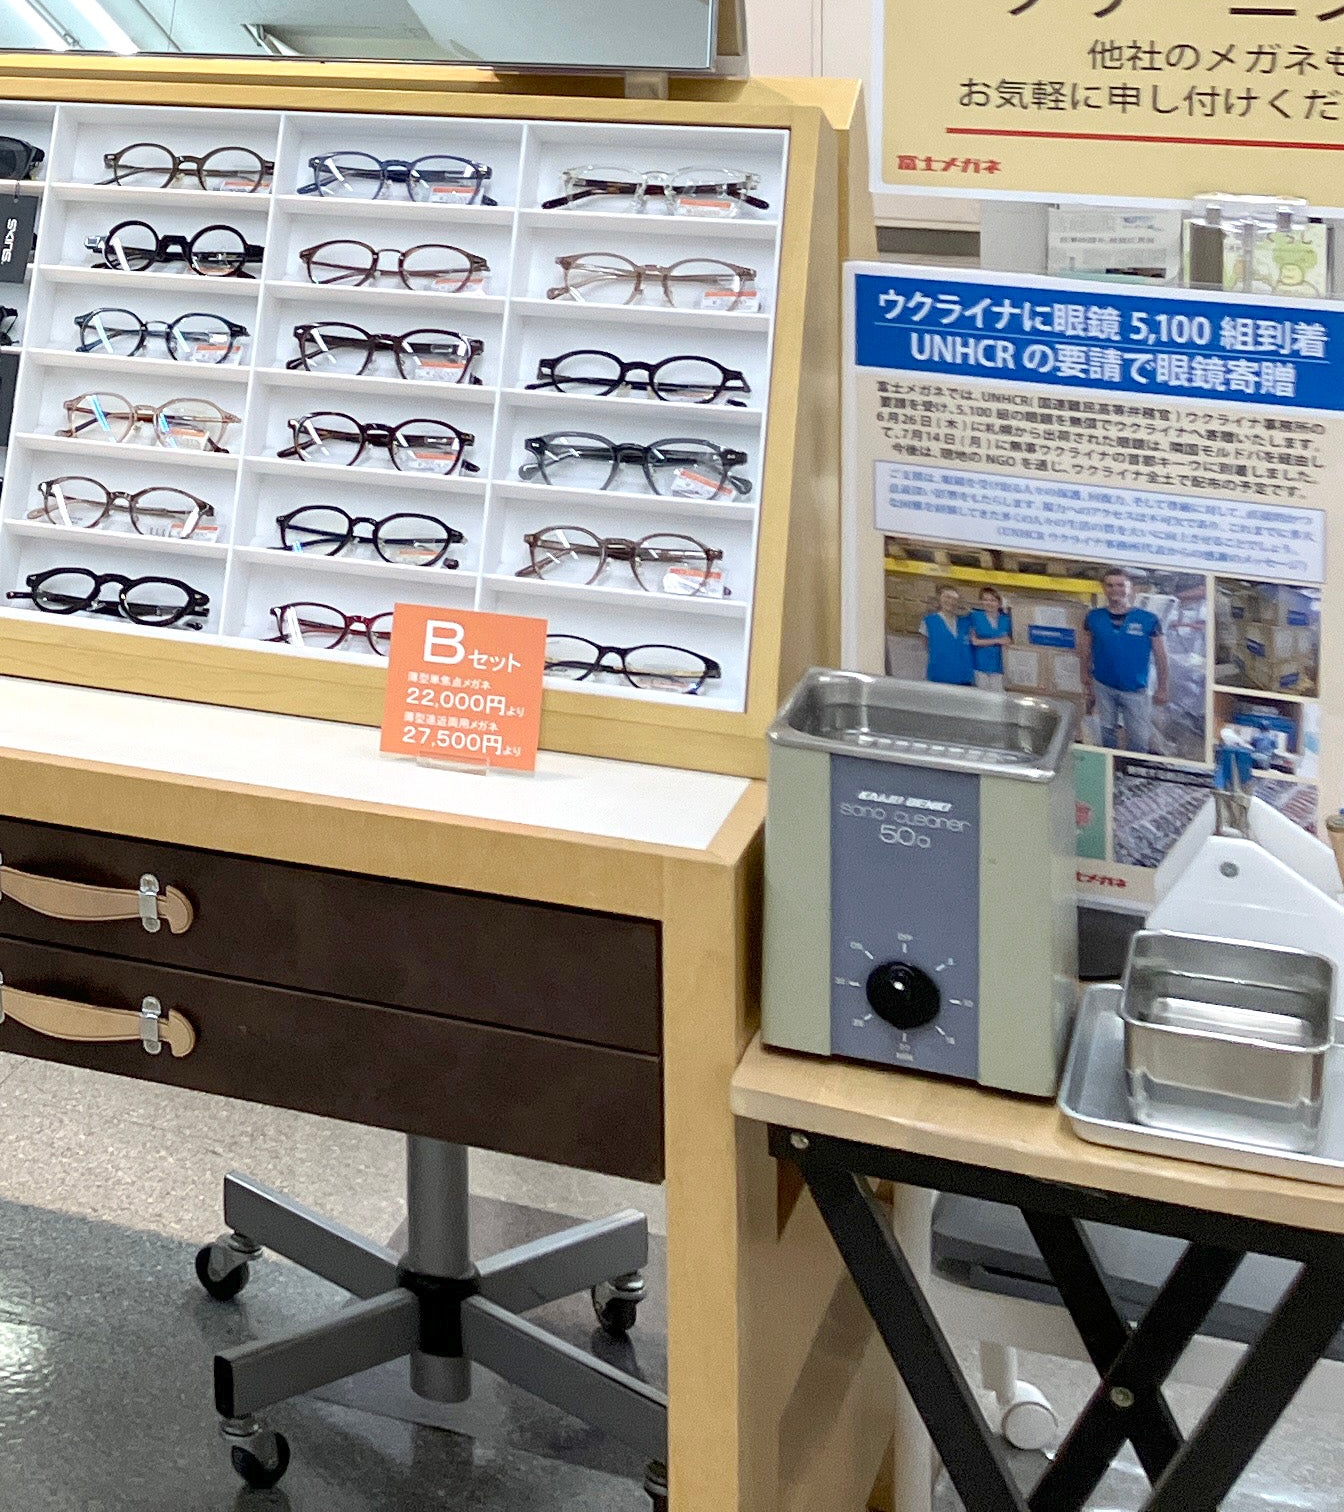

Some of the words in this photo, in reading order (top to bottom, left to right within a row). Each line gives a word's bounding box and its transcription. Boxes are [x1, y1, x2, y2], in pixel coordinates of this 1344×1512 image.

[897, 155, 1002, 174] 富士メガネ
[877, 288, 1122, 341] ウクライナに眼鏡
[1130, 311, 1210, 347] 5,100
[1219, 315, 1330, 360] 組到着
[911, 332, 1015, 371] UNHCR
[1023, 343, 1297, 399] の要請で眼鏡寄贈
[423, 619, 522, 673] Bセット
[405, 687, 525, 717] 22,000円より
[402, 726, 522, 756] 27,500円より
